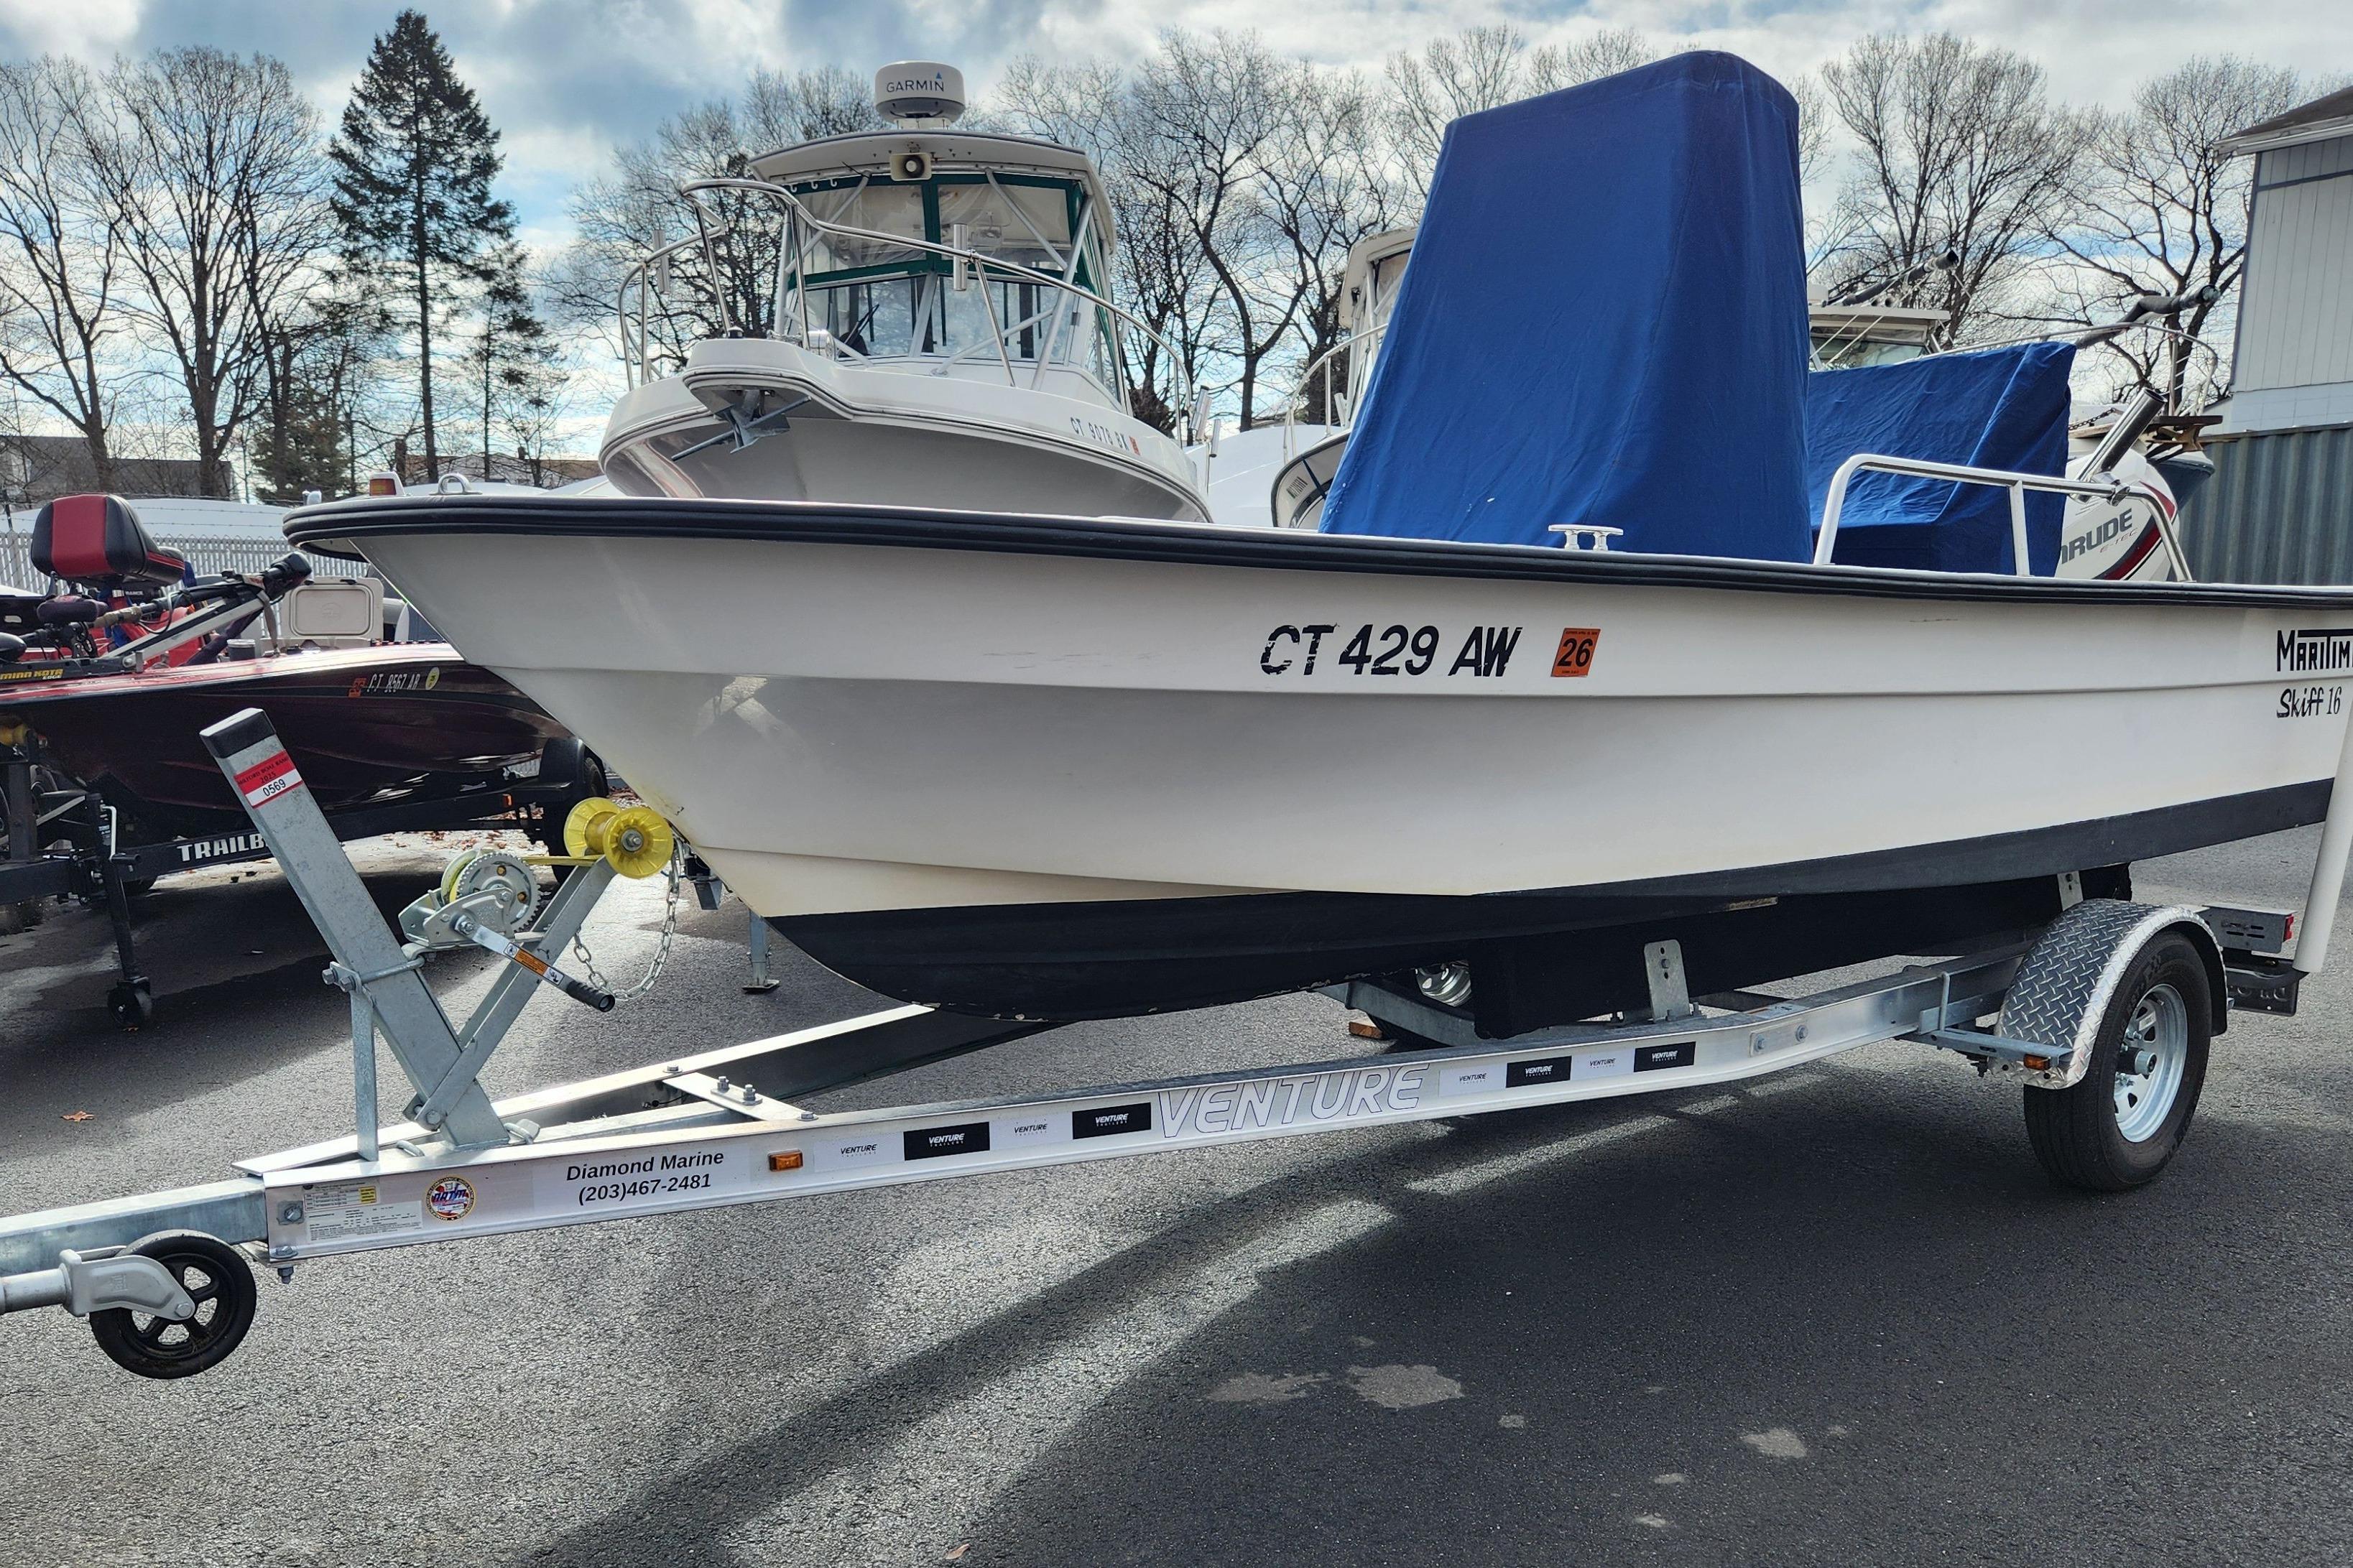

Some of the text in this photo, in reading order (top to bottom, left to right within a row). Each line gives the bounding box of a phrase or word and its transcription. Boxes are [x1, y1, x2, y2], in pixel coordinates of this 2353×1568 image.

[886, 79, 944, 93] GARMIN
[1259, 623, 1523, 677] CT 429 AW
[1556, 637, 1594, 667] 26
[2276, 628, 2353, 672] MARITIM
[2276, 686, 2342, 718] Skiff 16
[262, 778, 287, 797] 0569
[1652, 1050, 1678, 1059] VENTURE
[1589, 1057, 1616, 1067] VENTURE
[1525, 1064, 1553, 1075] VENTURE
[1459, 1072, 1487, 1082] VENTURE
[1157, 1062, 1431, 1138] VENTURE
[1095, 1113, 1129, 1124] VENTURE
[1014, 1123, 1048, 1133] VENTURE
[928, 1133, 966, 1144] VENTURE
[840, 1143, 878, 1155] VENTURE
[565, 1150, 725, 1182] Diamond Marine
[578, 1172, 712, 1206] (203)467-2481
